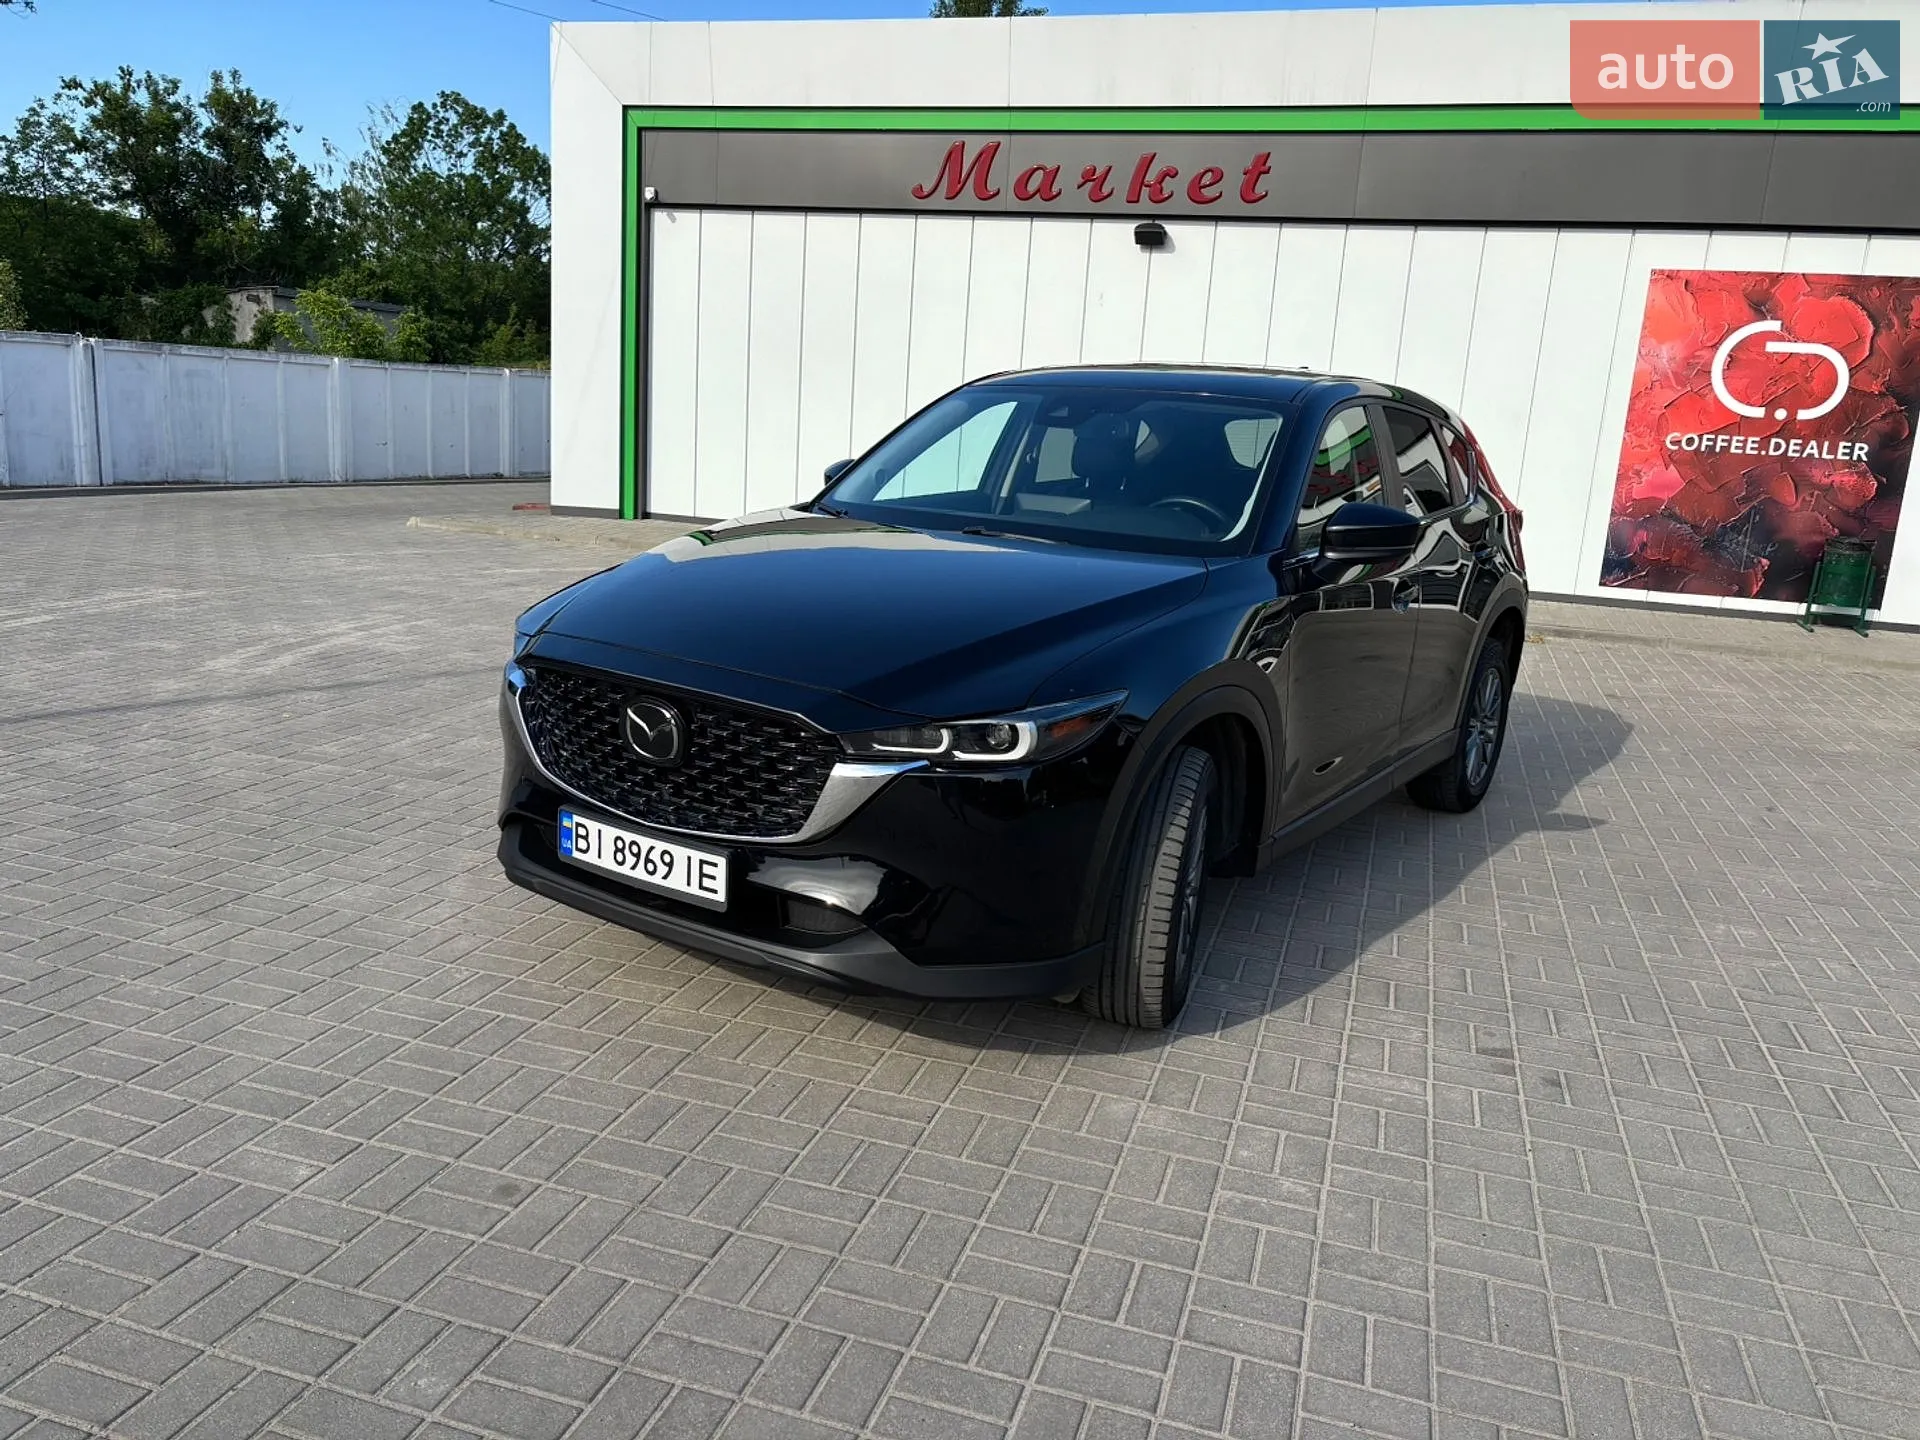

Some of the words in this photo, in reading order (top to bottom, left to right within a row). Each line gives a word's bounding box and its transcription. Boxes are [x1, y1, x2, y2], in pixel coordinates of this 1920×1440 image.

[911, 140, 1272, 204] Market
[1664, 432, 1869, 462] COFFEE.DEALER
[575, 822, 602, 859] BI
[613, 835, 674, 880] 8969
[686, 855, 718, 895] IE
